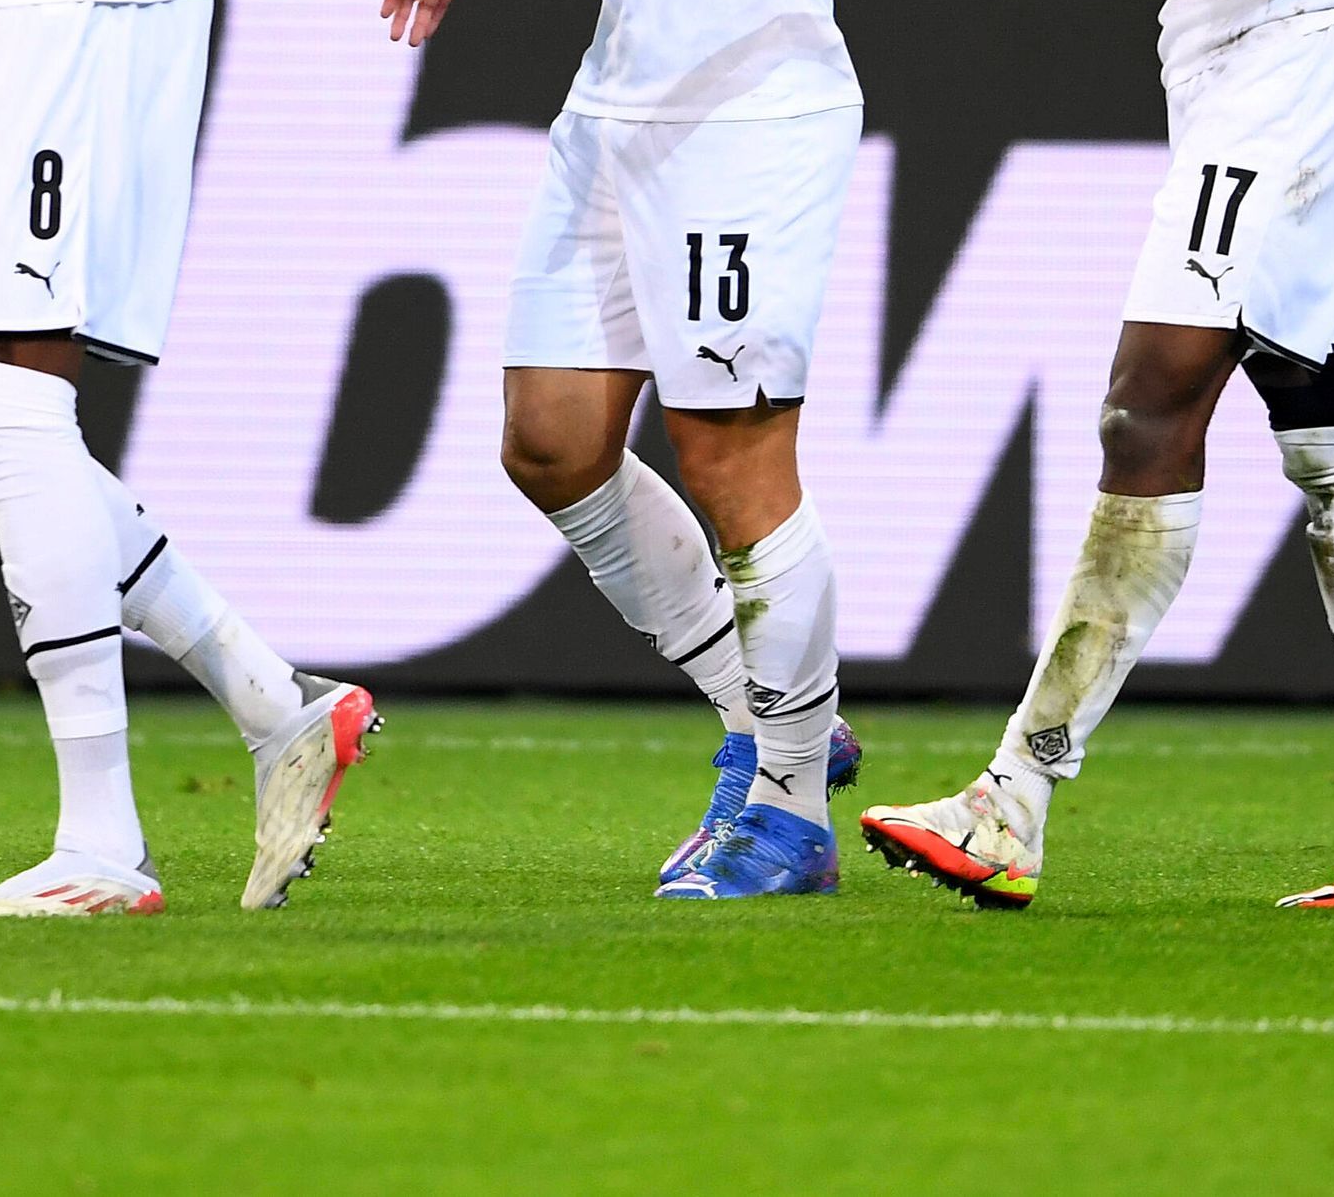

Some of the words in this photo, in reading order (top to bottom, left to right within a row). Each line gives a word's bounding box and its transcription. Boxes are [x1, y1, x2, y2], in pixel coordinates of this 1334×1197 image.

[29, 149, 63, 240] 8
[1187, 164, 1258, 256] 17
[686, 232, 750, 322] 13
